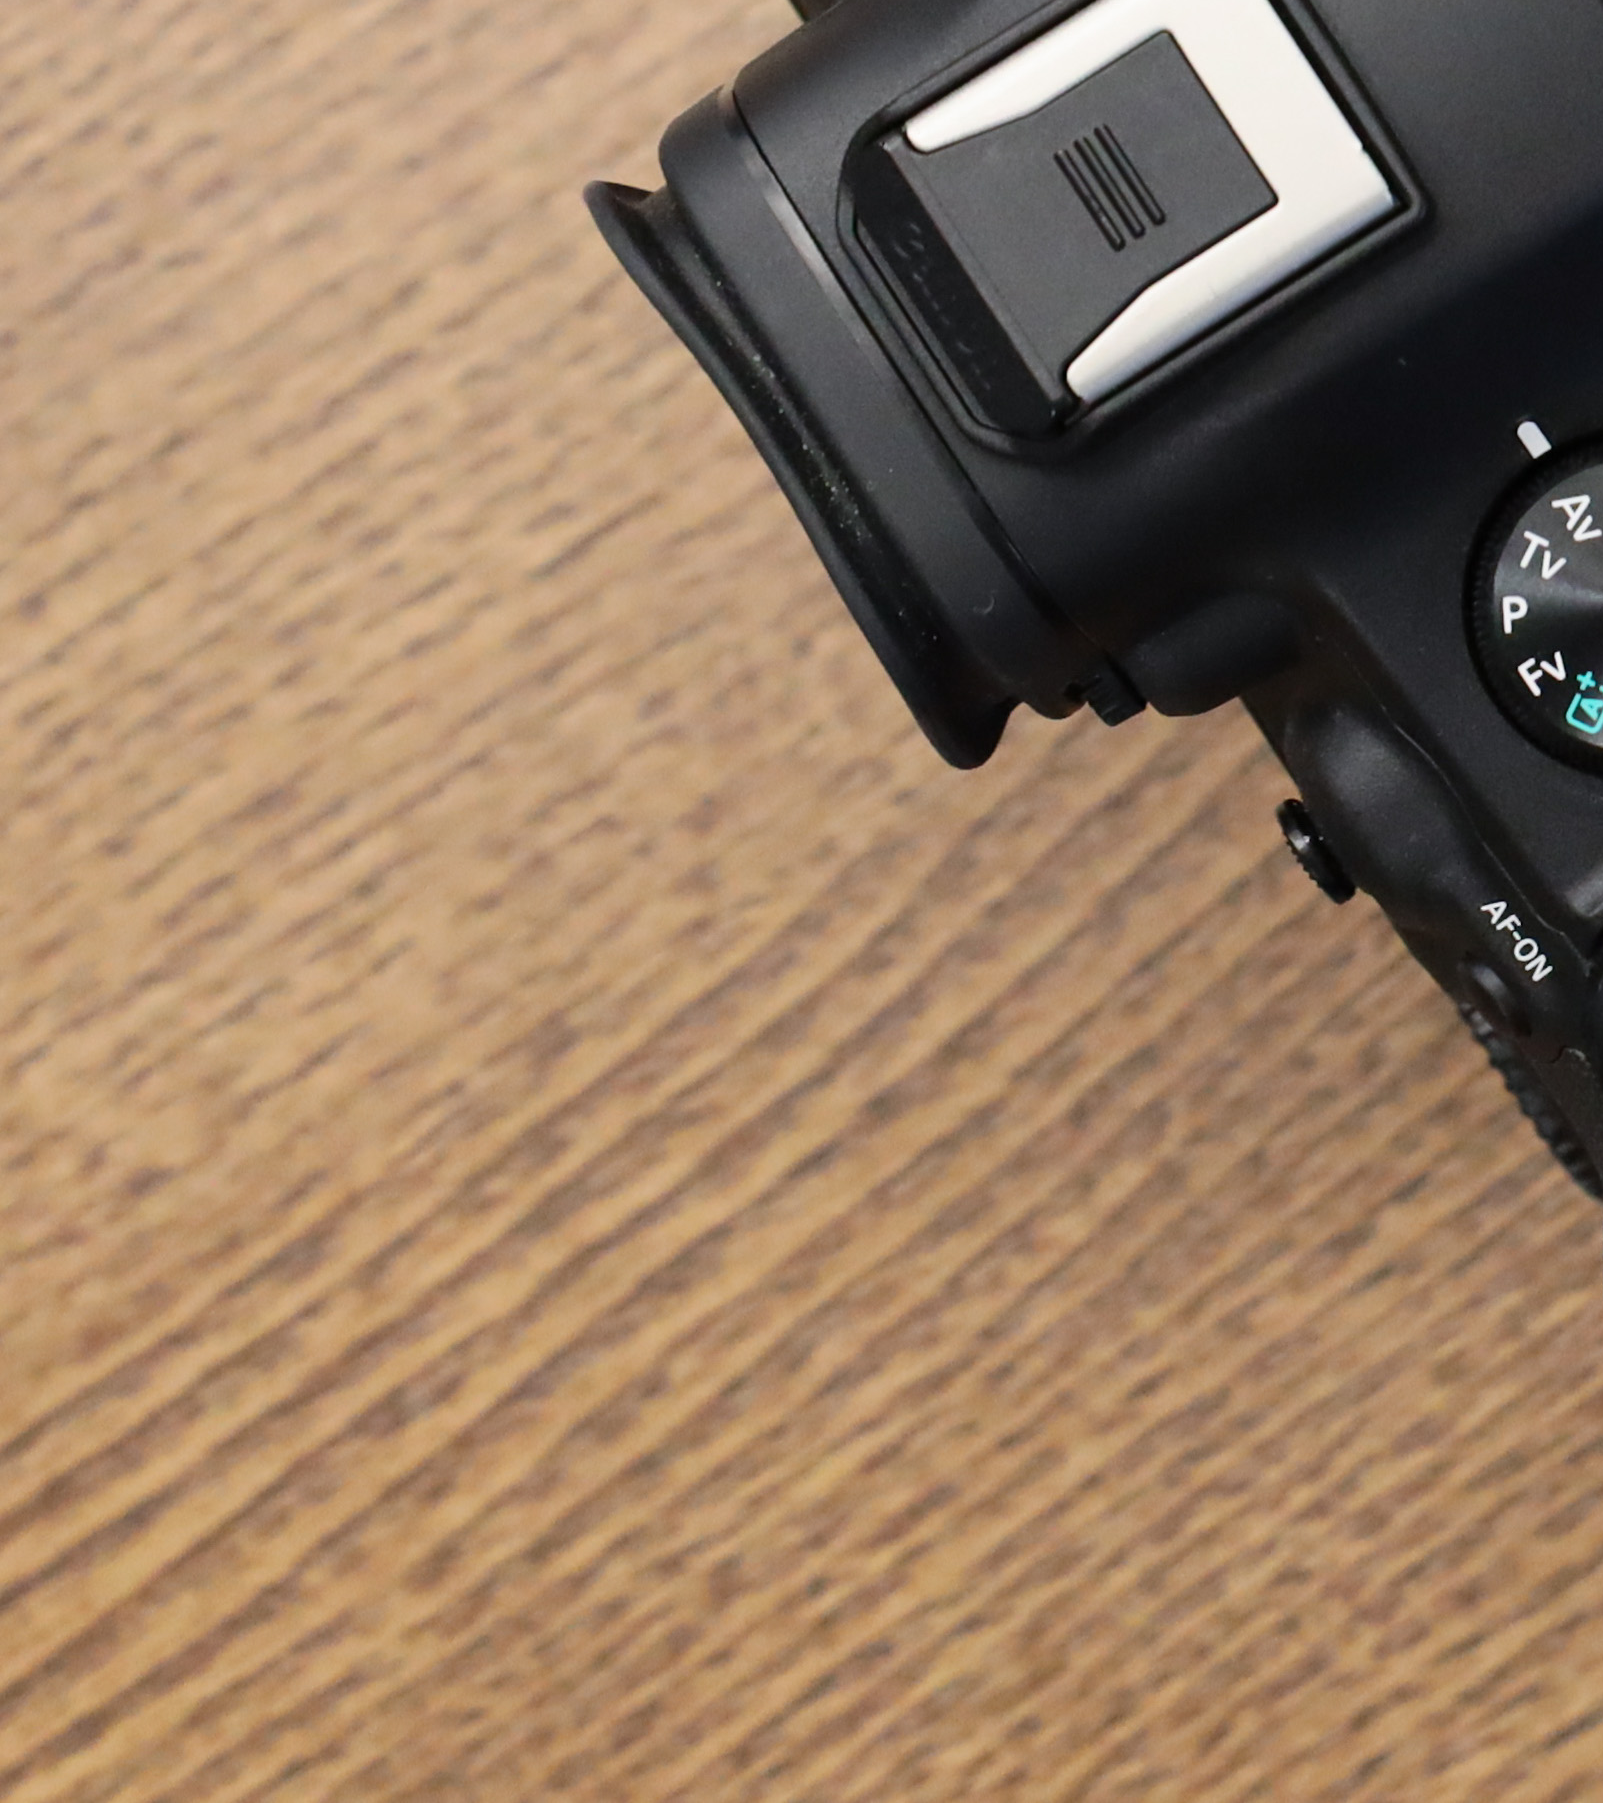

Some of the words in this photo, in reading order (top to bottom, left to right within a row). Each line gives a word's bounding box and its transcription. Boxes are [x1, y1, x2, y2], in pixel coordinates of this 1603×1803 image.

[1552, 495, 1602, 542] Av
[1519, 531, 1566, 579] Tv
[1502, 596, 1528, 634] P
[1517, 652, 1567, 697] Fv
[1480, 899, 1554, 984] AF-ON
